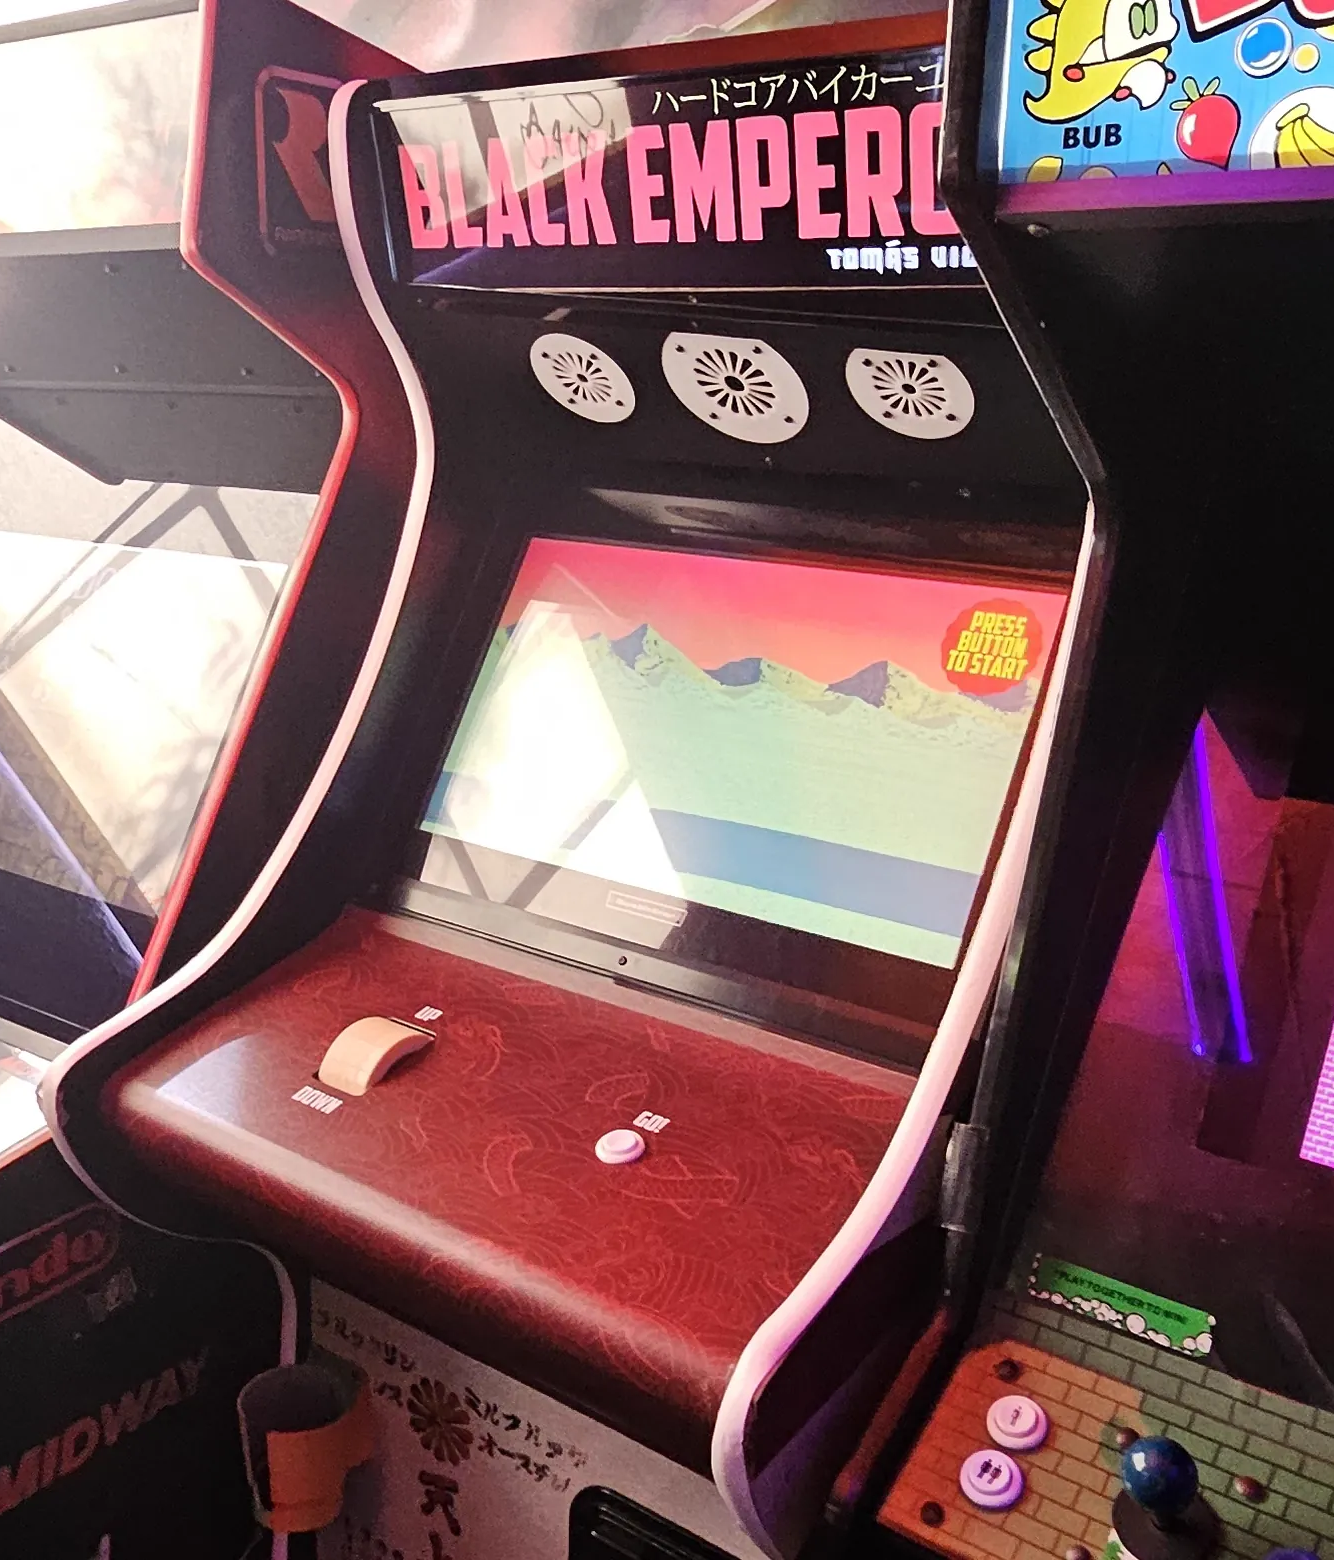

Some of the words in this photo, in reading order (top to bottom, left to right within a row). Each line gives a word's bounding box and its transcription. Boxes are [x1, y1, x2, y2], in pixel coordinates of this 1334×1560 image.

[1063, 124, 1122, 149] BUB
[398, 129, 617, 248] BLACK
[826, 239, 919, 275] TOMÁS
[969, 610, 1027, 637] PRESS
[957, 630, 1028, 658] BUTTON
[946, 649, 970, 673] TO
[968, 652, 1029, 681] START
[414, 1005, 444, 1021] UP
[291, 1085, 344, 1114] DOWN
[632, 1110, 671, 1134] GO!
